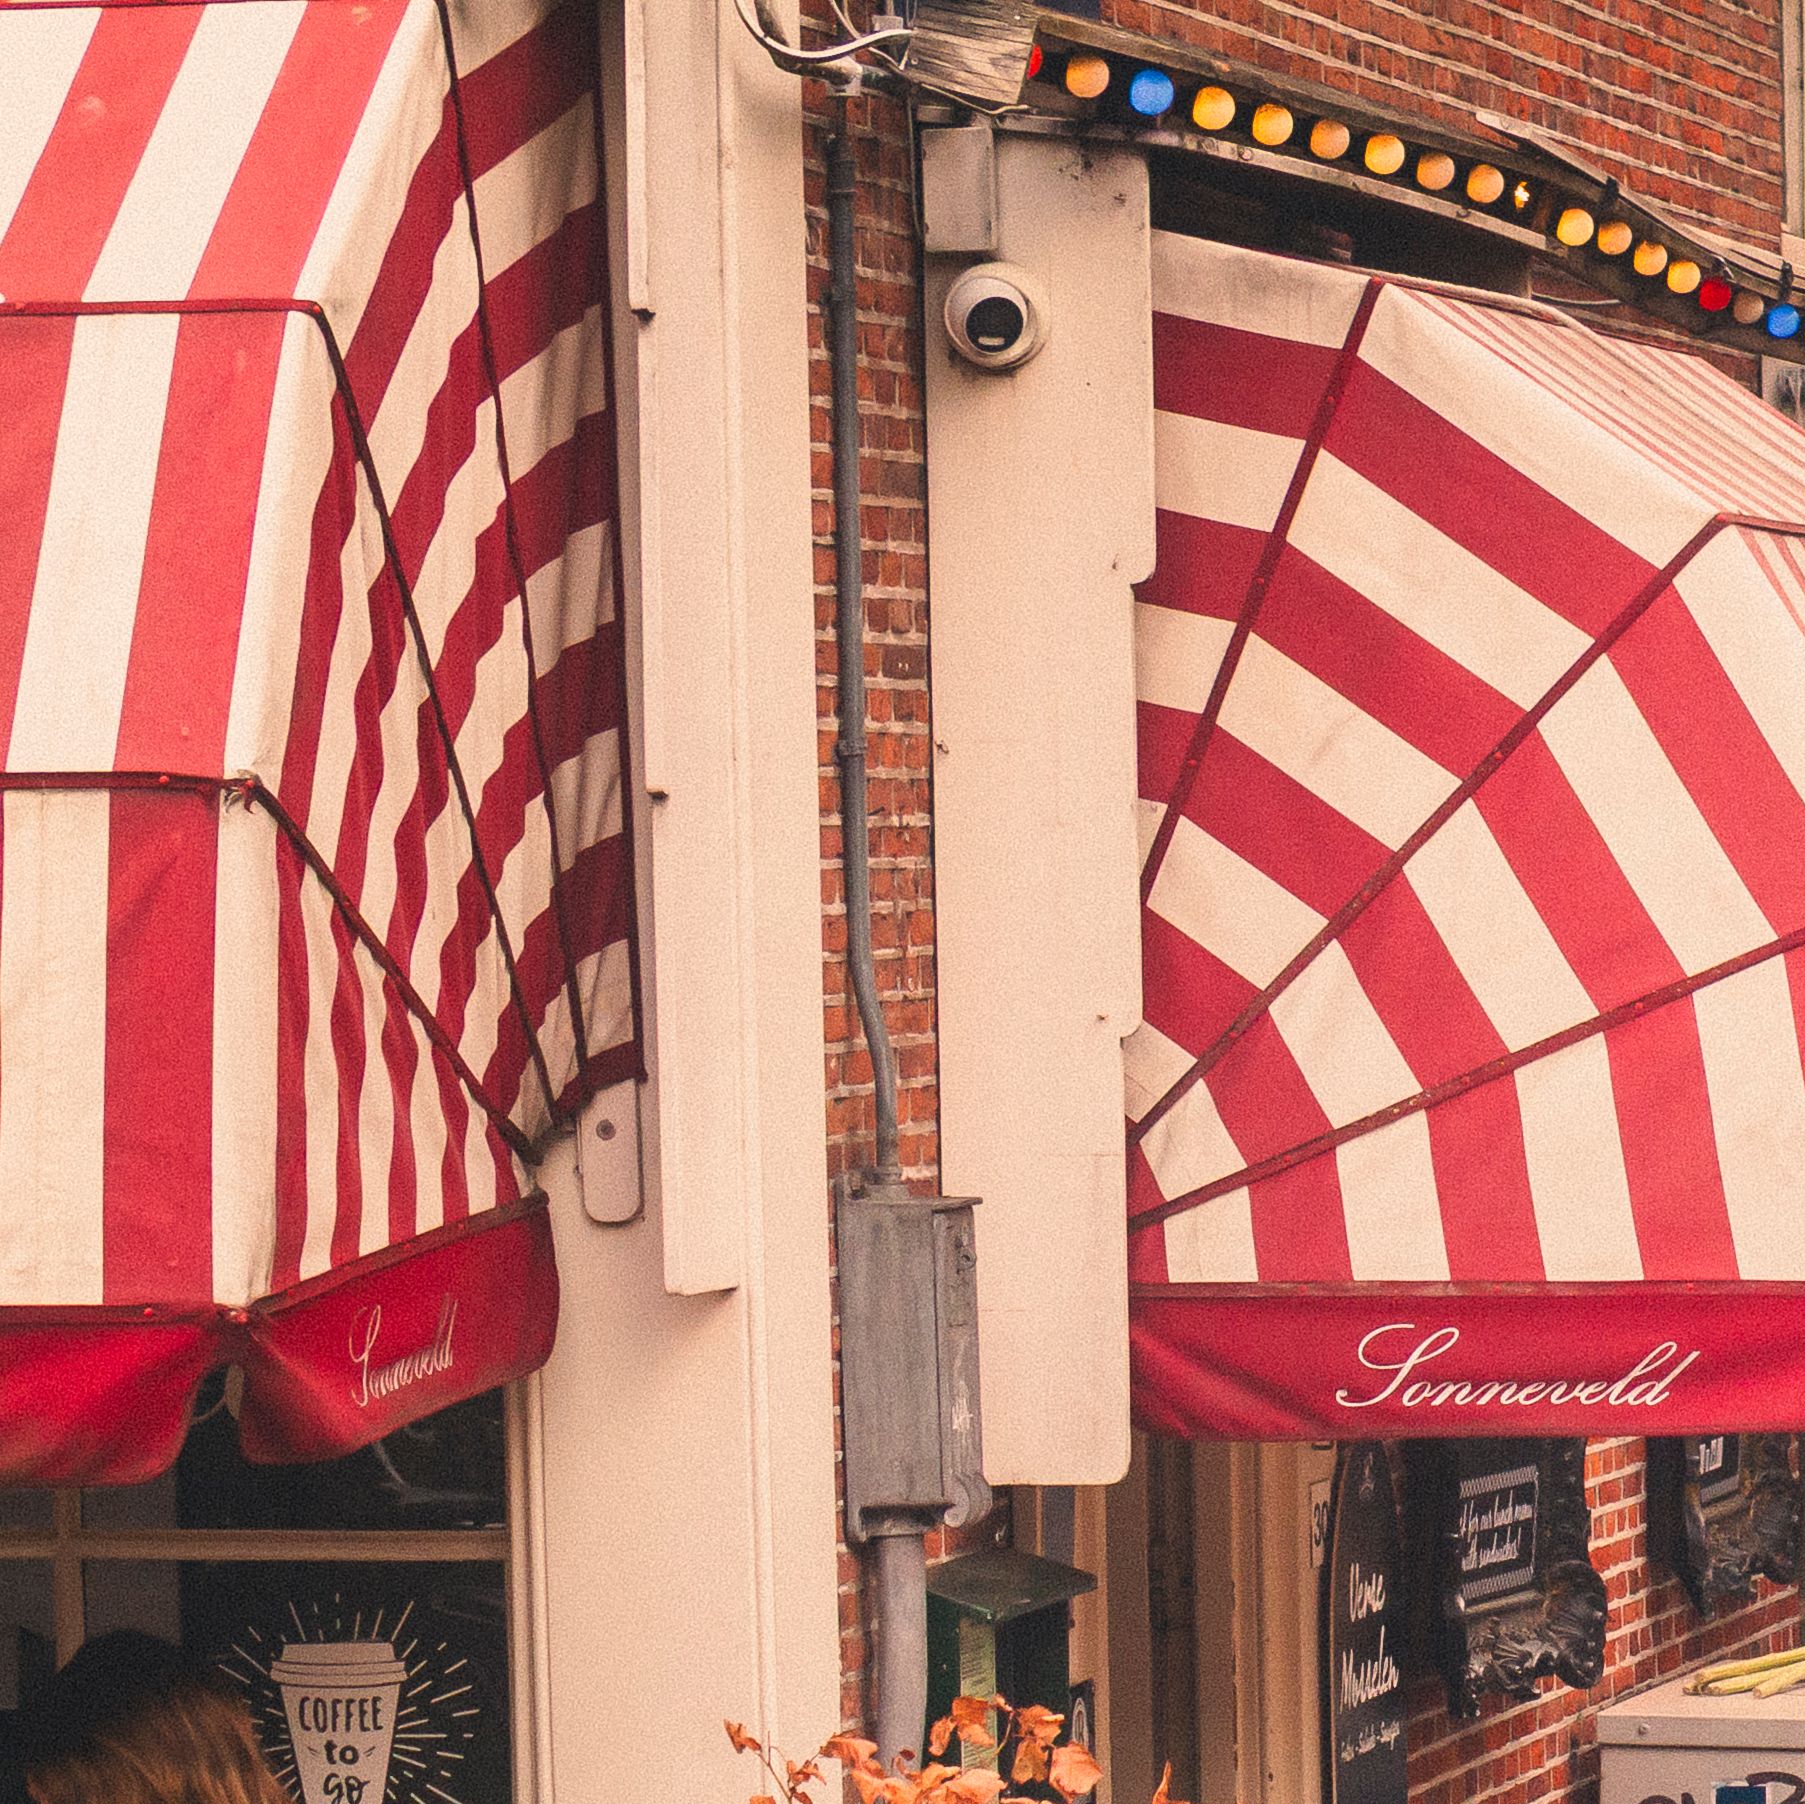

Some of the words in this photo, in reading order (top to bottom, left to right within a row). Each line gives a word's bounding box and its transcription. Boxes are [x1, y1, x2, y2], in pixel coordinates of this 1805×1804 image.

[348, 1292, 458, 1408] Sonneveld
[1335, 1323, 1701, 1408] Sonneveld
[298, 1696, 384, 1734] COFFEE
[324, 1739, 360, 1766] to
